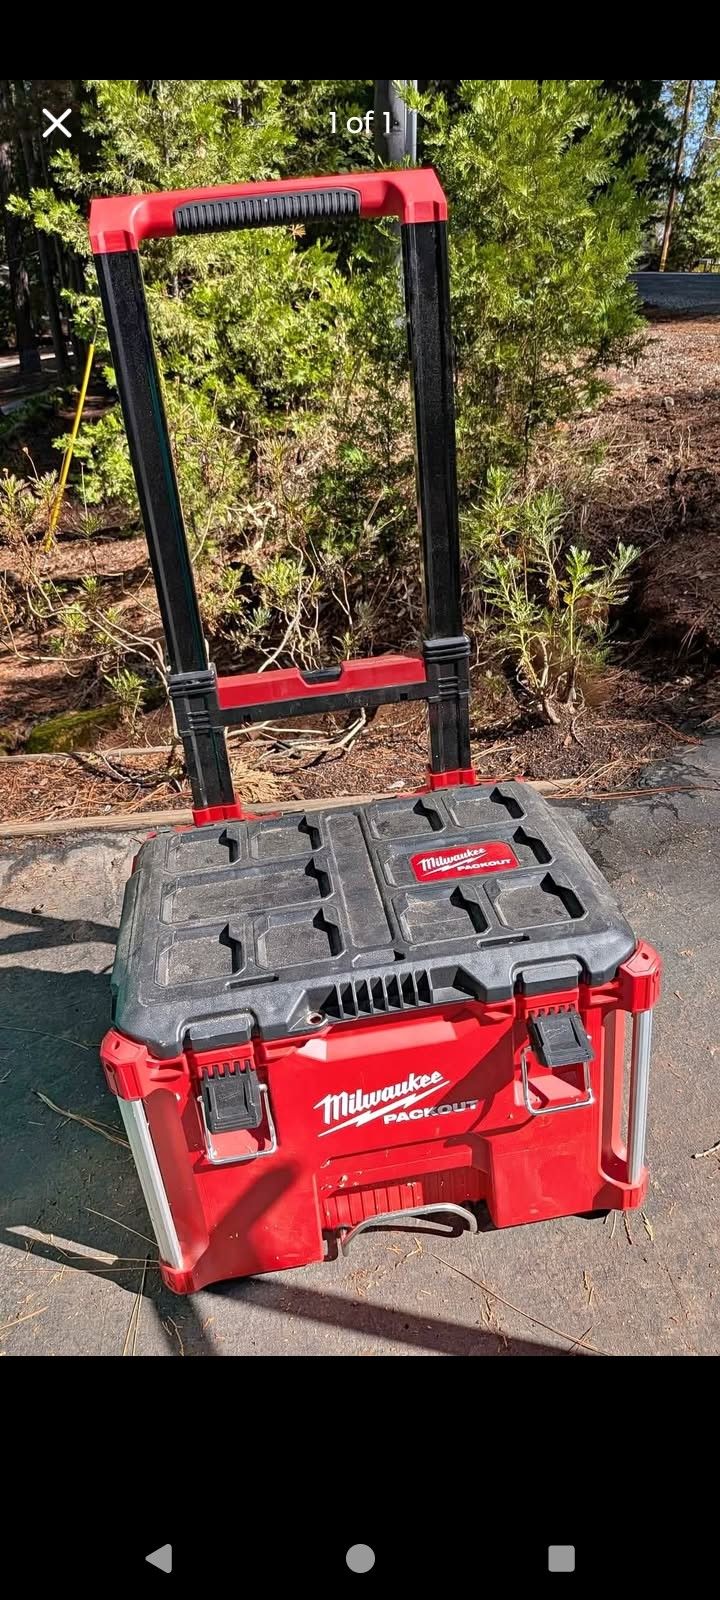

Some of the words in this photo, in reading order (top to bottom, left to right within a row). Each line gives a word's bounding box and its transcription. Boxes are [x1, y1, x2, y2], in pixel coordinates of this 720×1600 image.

[416, 848, 487, 871] Milwaukee
[457, 859, 511, 871] PACKOUT
[313, 1071, 442, 1124] Milwaukee
[383, 1101, 478, 1124] PACKOUT
